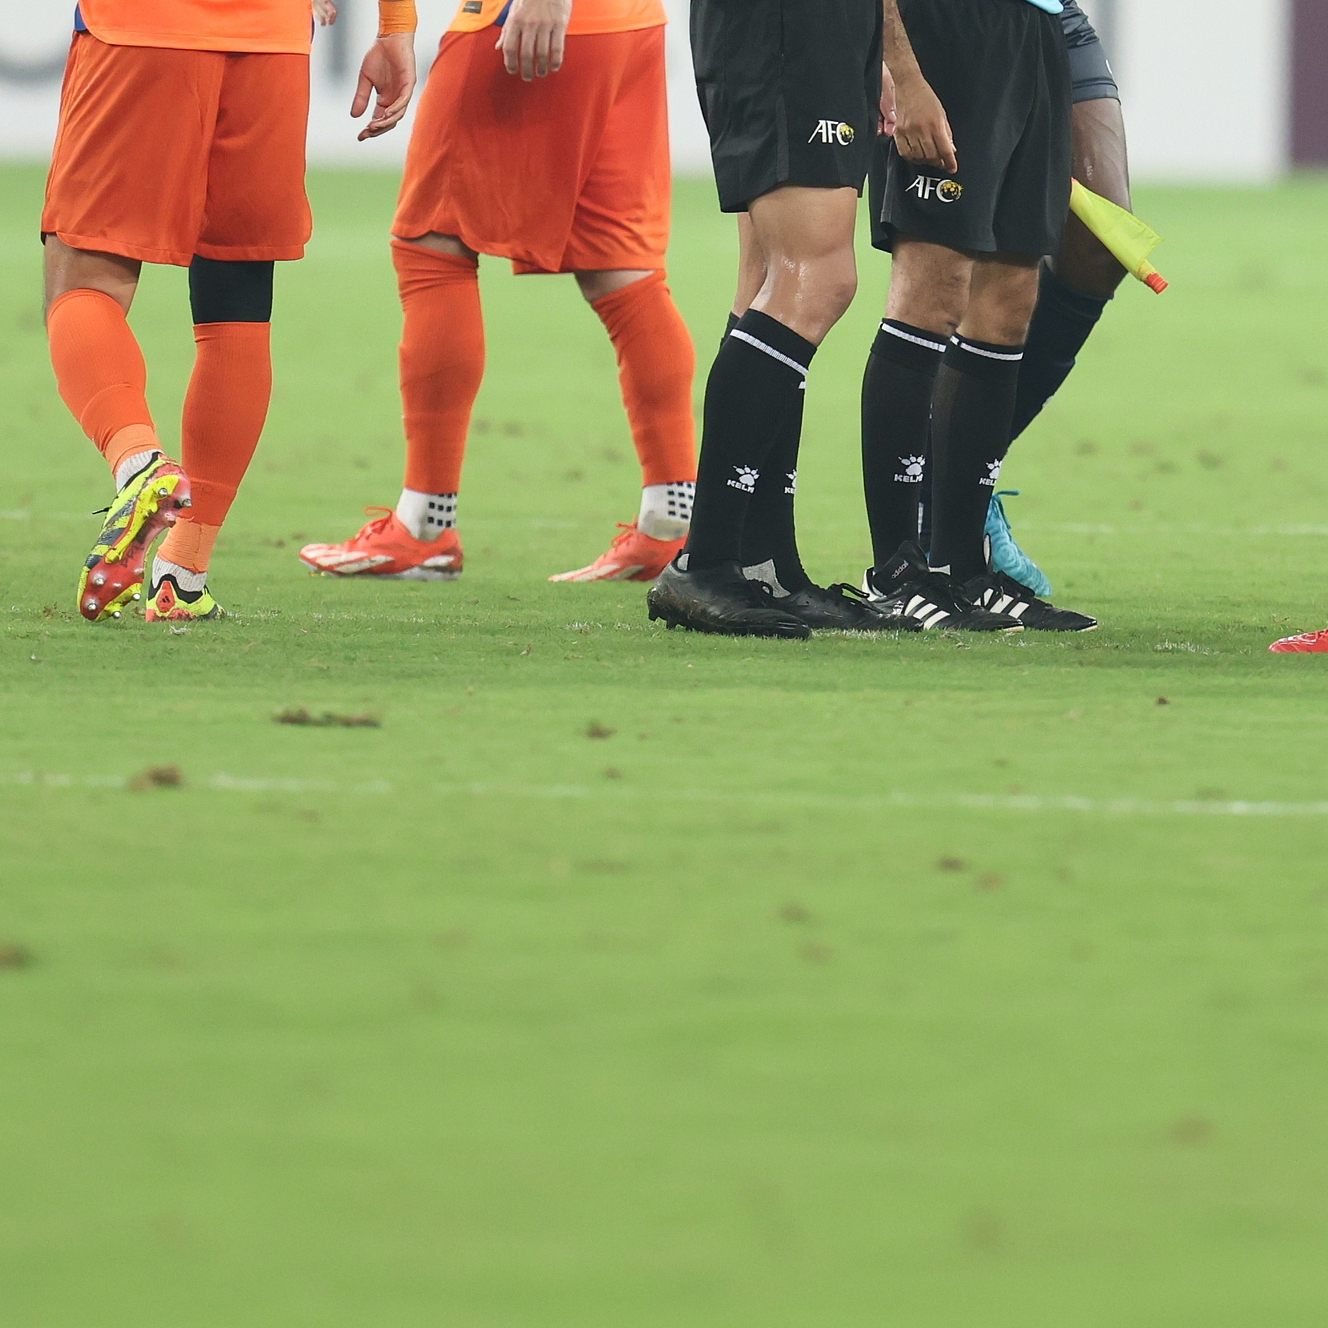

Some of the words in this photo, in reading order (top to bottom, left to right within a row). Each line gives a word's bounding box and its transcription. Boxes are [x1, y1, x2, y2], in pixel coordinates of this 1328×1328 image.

[807, 119, 855, 146] AFC
[905, 174, 964, 203] AFC
[726, 479, 755, 494] KELM
[894, 474, 923, 482] KELM
